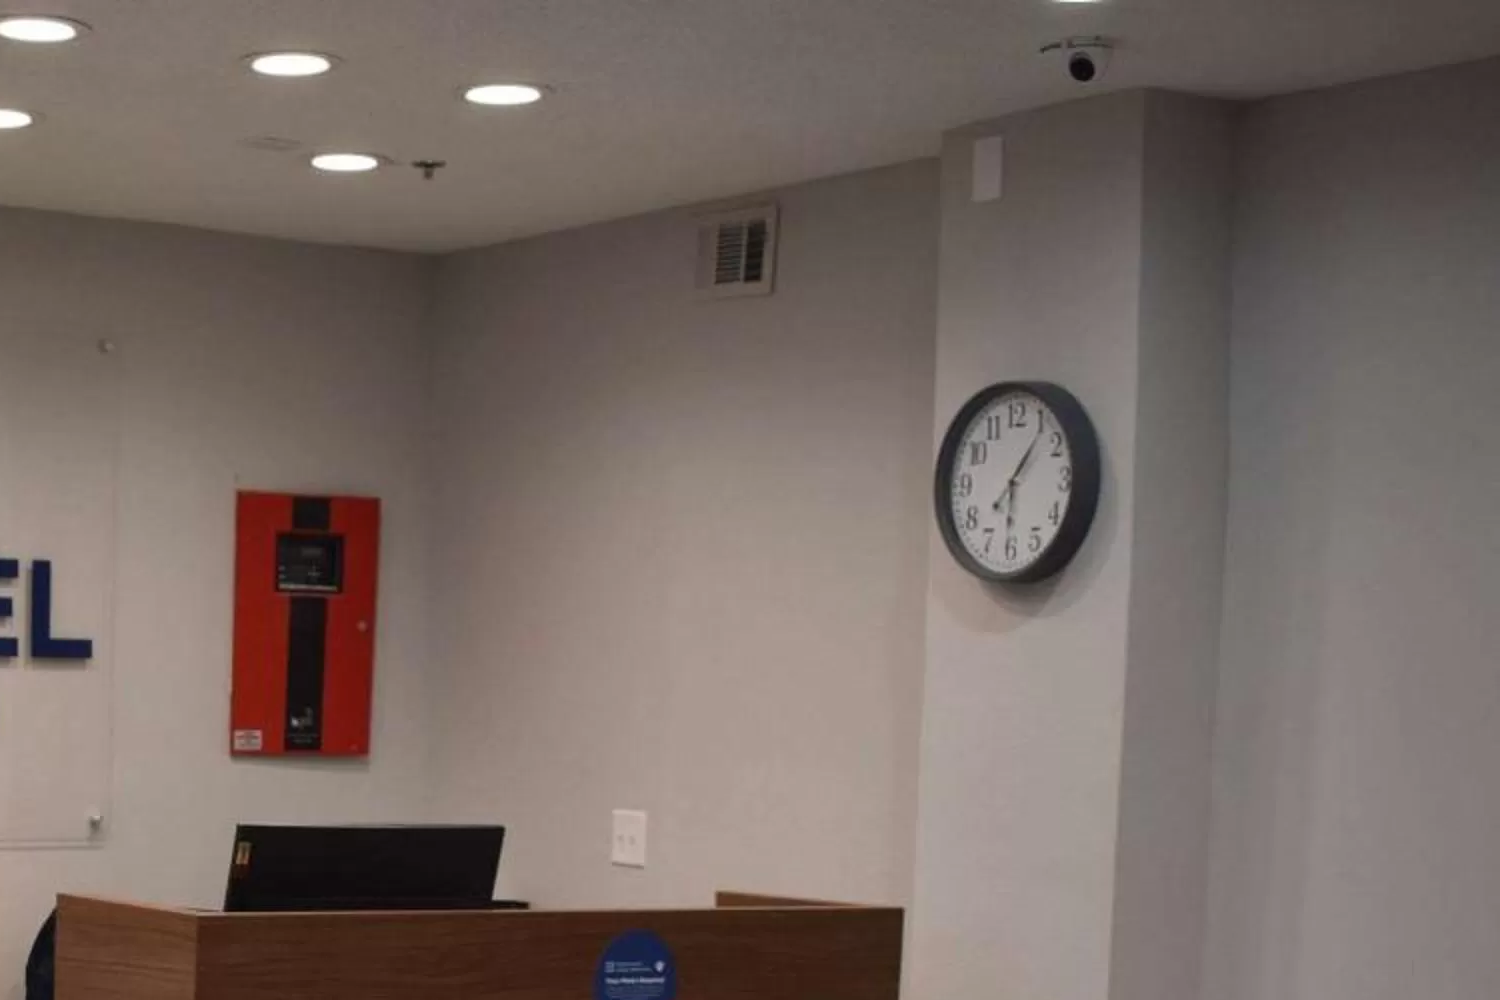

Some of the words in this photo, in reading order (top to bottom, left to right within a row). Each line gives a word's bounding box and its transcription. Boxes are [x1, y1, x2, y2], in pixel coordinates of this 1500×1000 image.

[1008, 402, 1027, 428] 12
[1037, 408, 1044, 433] 1
[986, 415, 1001, 441] 11
[970, 441, 987, 465] 10
[1050, 431, 1063, 457] 2
[959, 473, 973, 497] 9
[1058, 465, 1073, 493] 3
[966, 505, 978, 530] 8
[1048, 501, 1060, 526] 4
[983, 527, 995, 553] 7
[1005, 536, 1017, 560] 6
[1028, 526, 1041, 552] 5
